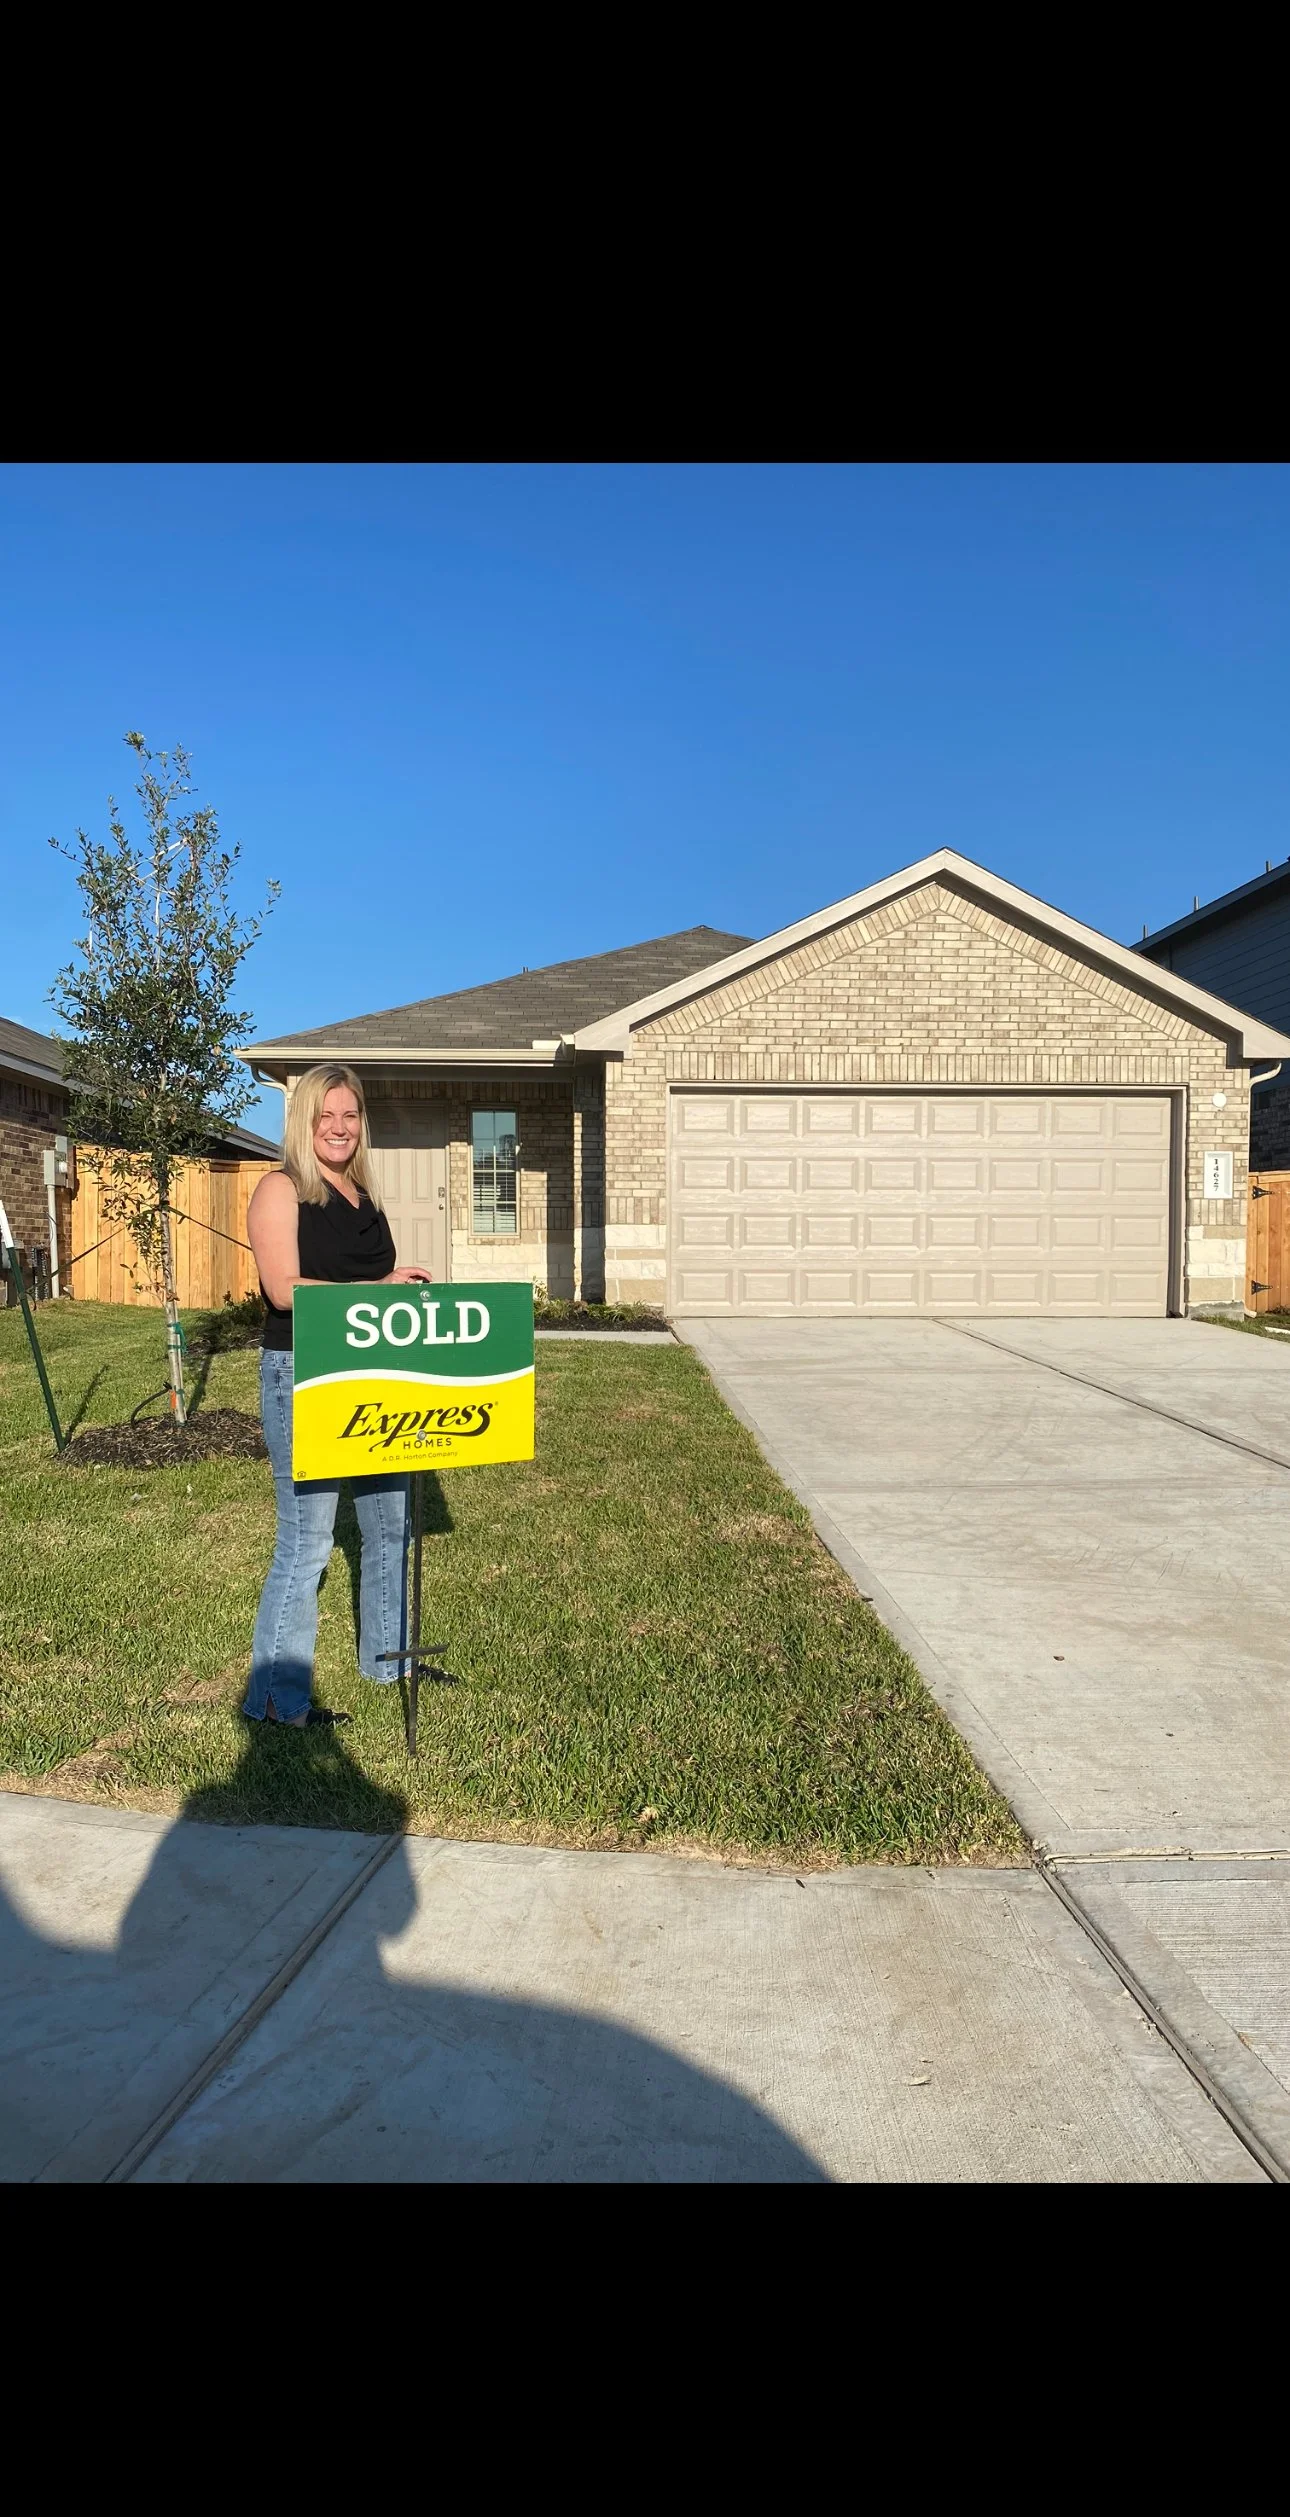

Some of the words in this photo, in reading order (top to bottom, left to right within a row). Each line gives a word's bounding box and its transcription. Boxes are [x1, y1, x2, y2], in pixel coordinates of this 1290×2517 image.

[345, 1301, 490, 1348] SOLD
[337, 1401, 493, 1452] Express
[403, 1437, 452, 1449] HOMES
[427, 1451, 458, 1459] Company
